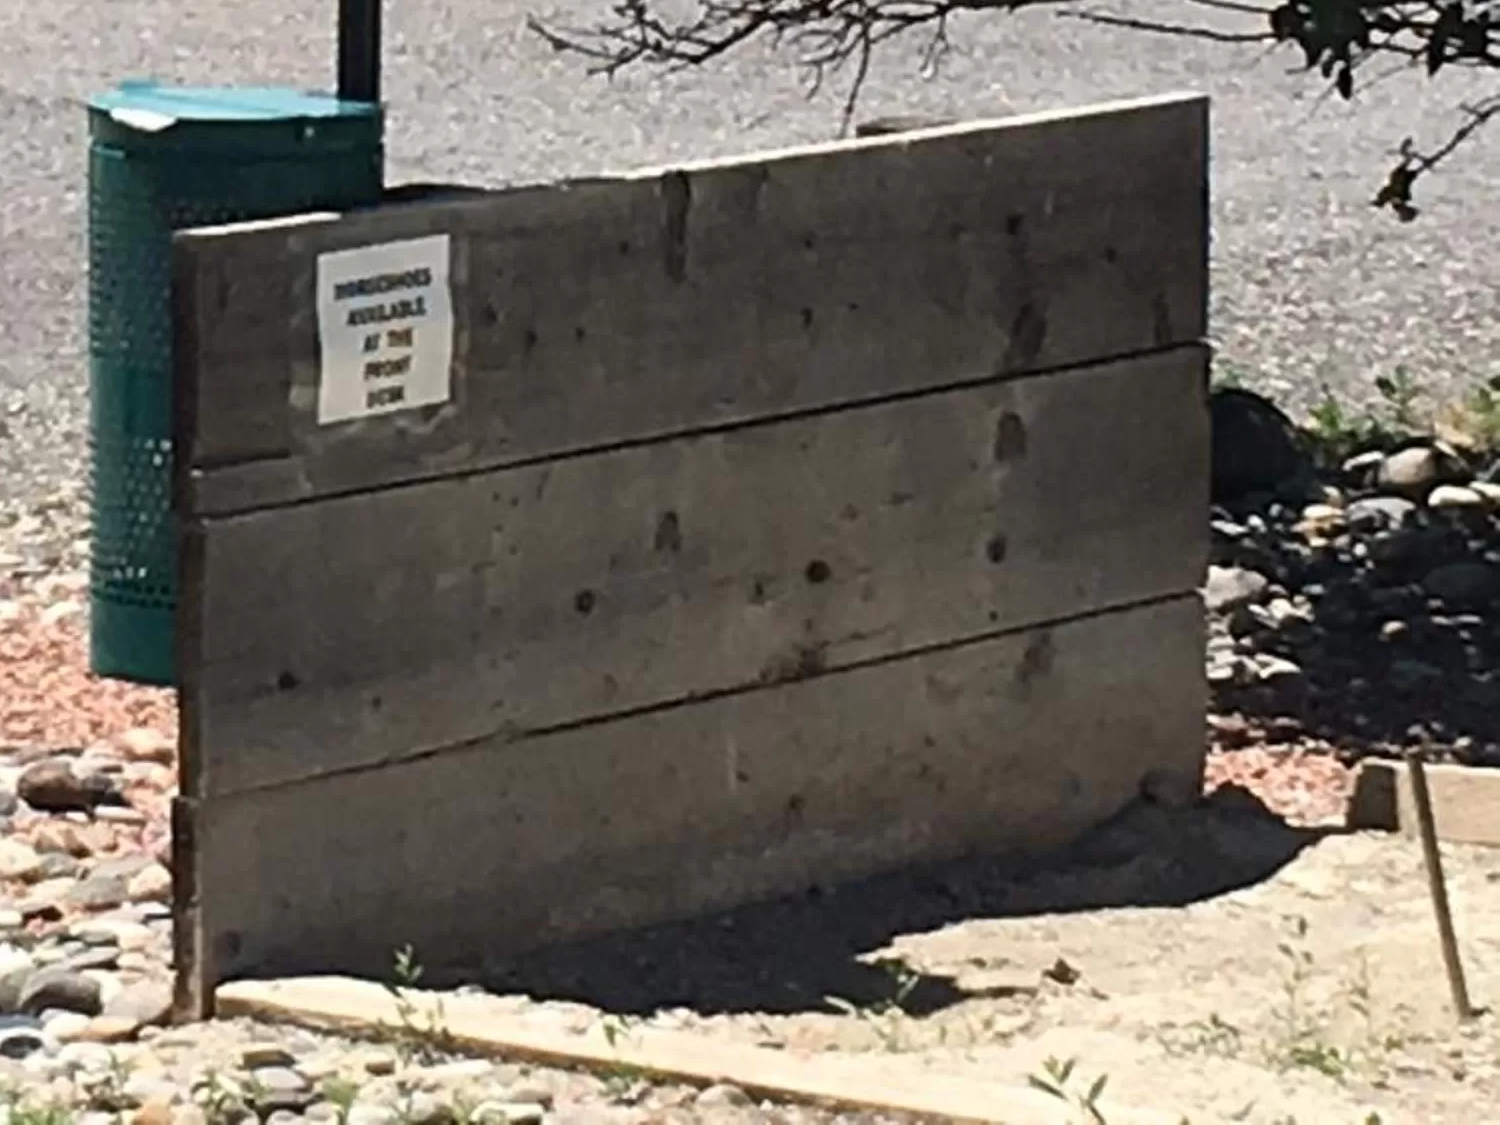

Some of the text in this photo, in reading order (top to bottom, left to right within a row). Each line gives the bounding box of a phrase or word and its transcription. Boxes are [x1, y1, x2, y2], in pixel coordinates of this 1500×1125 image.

[346, 296, 426, 327] AVAILABLE
[363, 327, 413, 354] AT THE
[363, 354, 412, 381] FRONT
